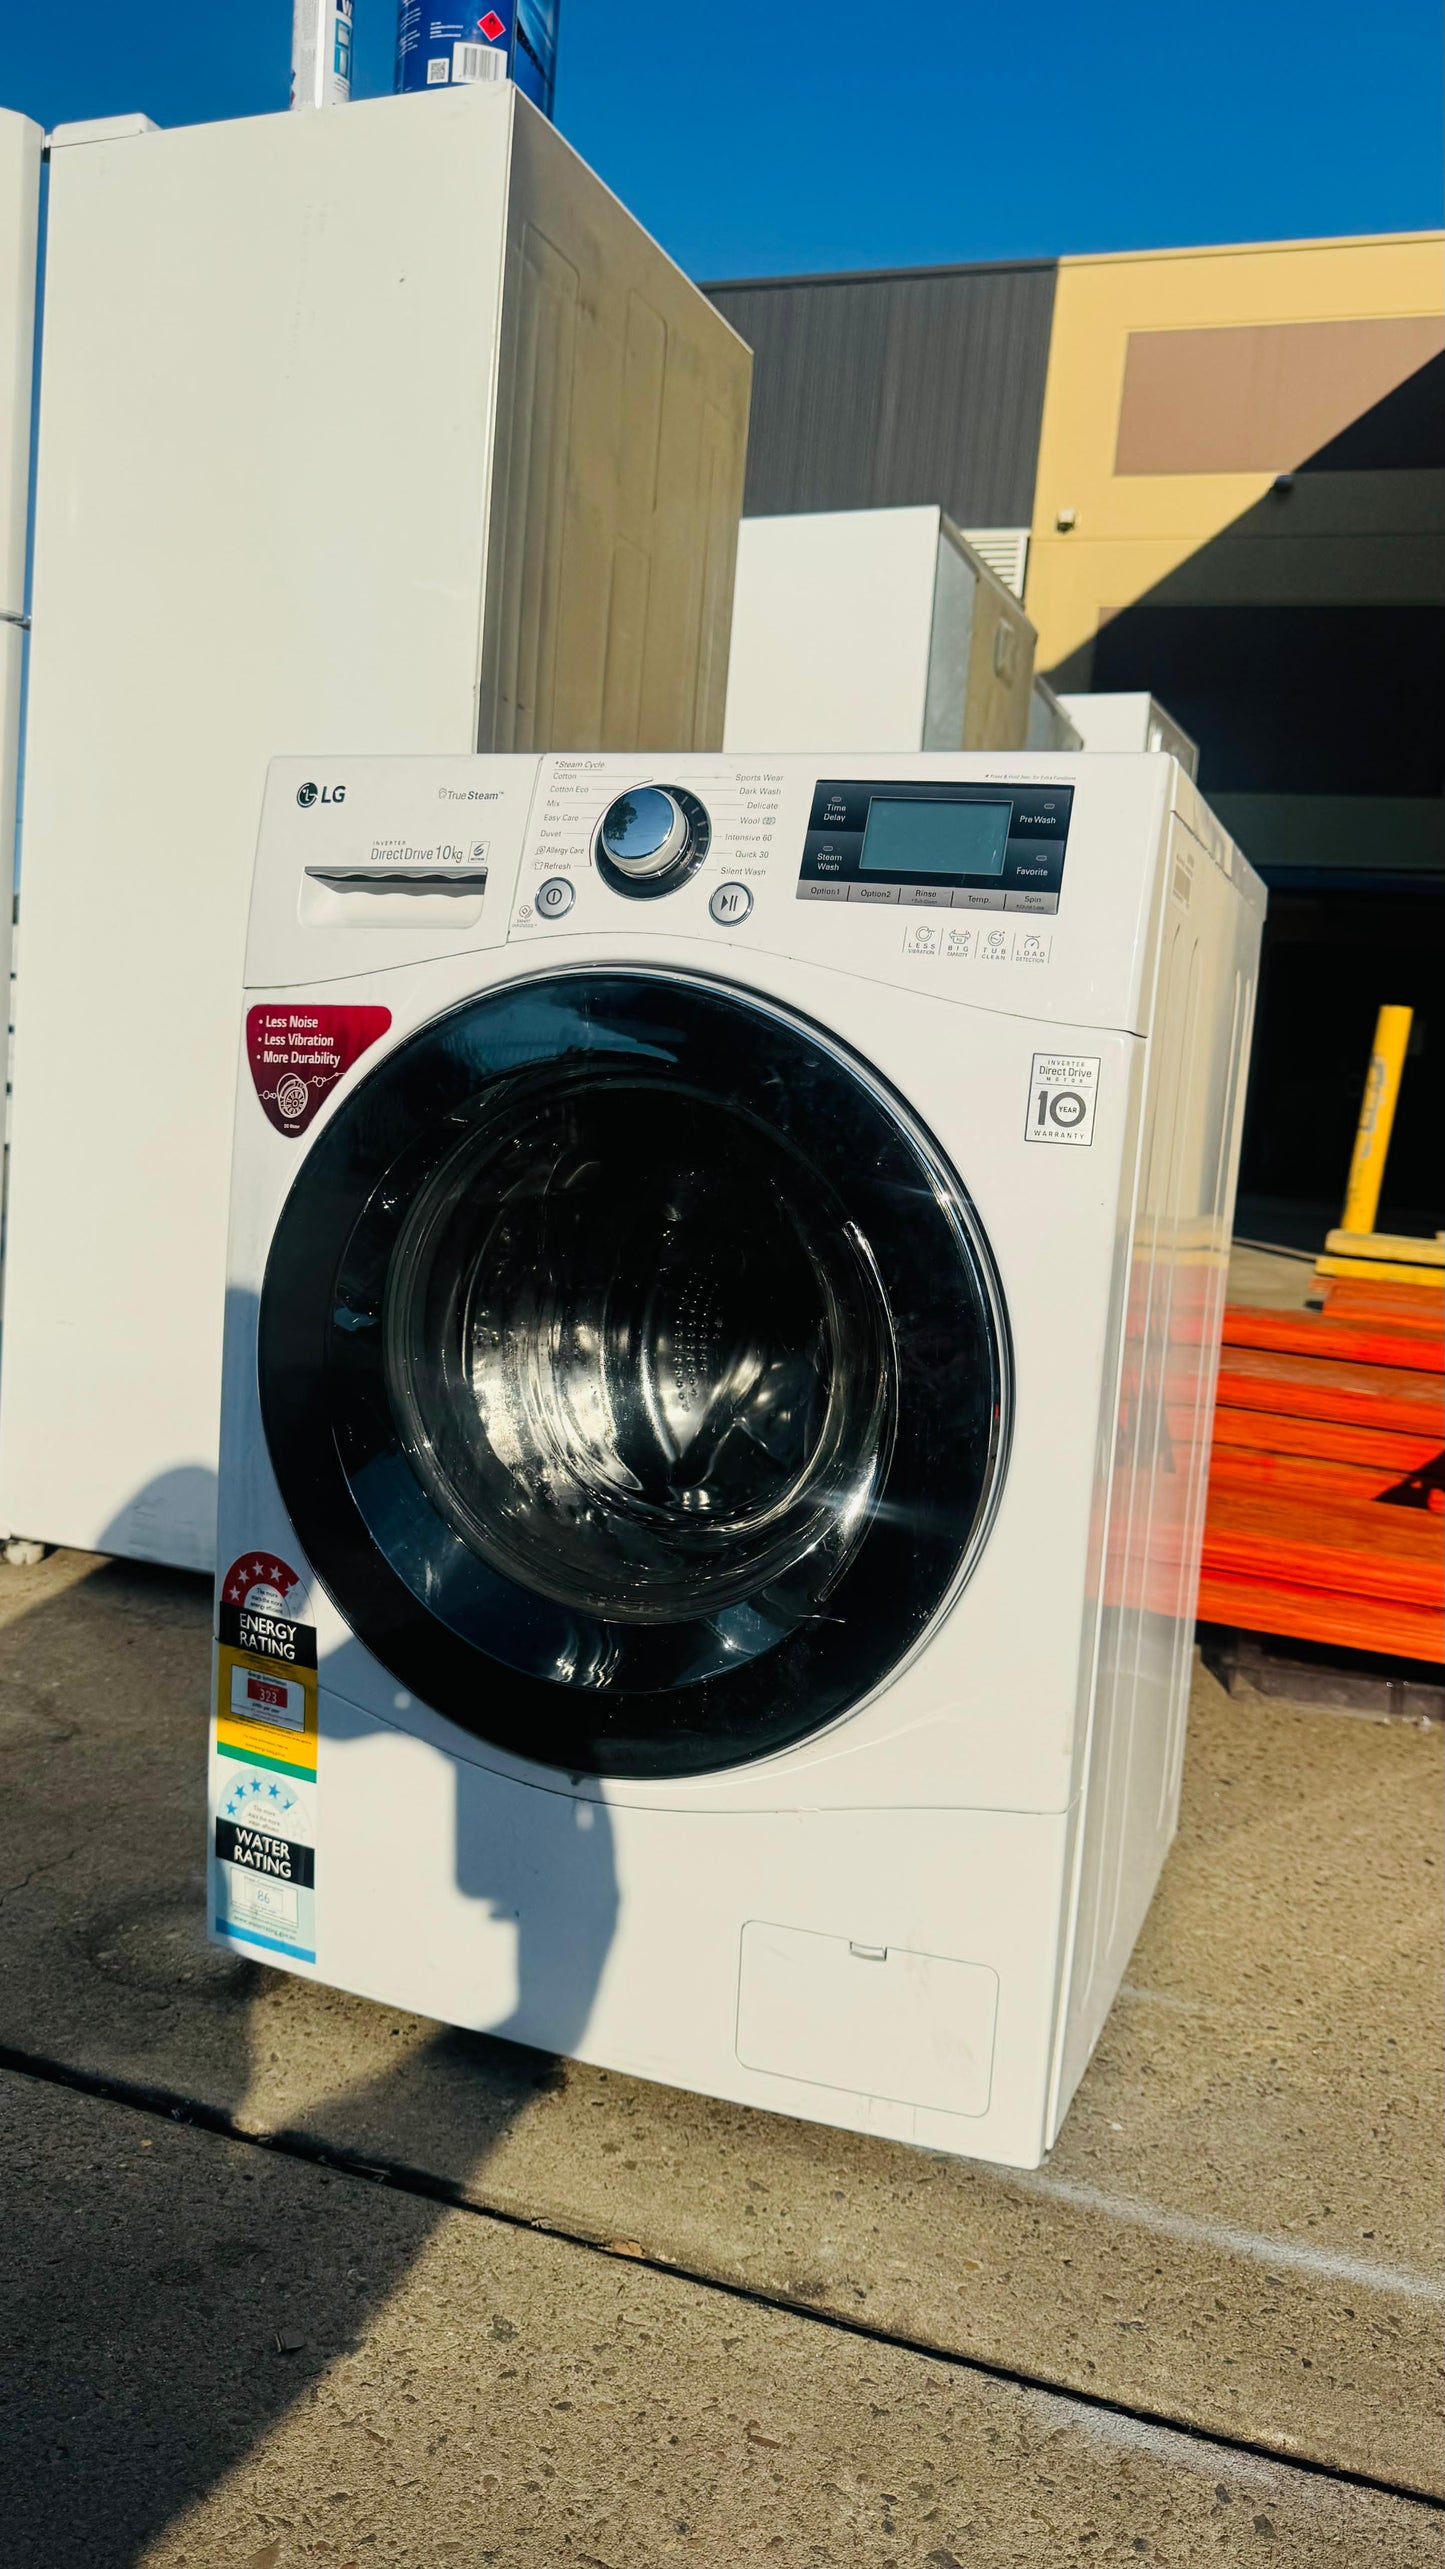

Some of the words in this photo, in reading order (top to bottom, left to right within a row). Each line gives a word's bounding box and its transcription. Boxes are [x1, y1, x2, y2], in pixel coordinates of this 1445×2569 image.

[736, 774, 760, 782] Sports
[321, 785, 346, 804] LG
[544, 814, 560, 822] Easy
[824, 813, 846, 822] Delay
[1034, 816, 1056, 824] Wash
[436, 845, 463, 863] 10kg
[546, 847, 568, 855] Allergy
[817, 853, 842, 861] Steam
[720, 867, 742, 875] Silent
[1016, 867, 1048, 876] Favorite
[968, 895, 991, 904] Temp.
[266, 1016, 287, 1028] Less
[289, 1016, 319, 1028] Noise
[264, 1033, 286, 1046] Less
[288, 1034, 334, 1046] Vibration
[263, 1051, 288, 1063] More
[291, 1051, 340, 1068] Durability
[1039, 1066, 1066, 1076] Direct
[1068, 1067, 1092, 1078] Drive
[1038, 1091, 1086, 1128] 10
[1034, 1130, 1084, 1140] WARRANTY
[240, 1613, 297, 1641] ENERGY
[240, 1635, 295, 1660] RATING
[260, 1689, 277, 1704] 323
[236, 1827, 290, 1860] WATER
[234, 1845, 292, 1879] RATING
[258, 1890, 270, 1904] 86
